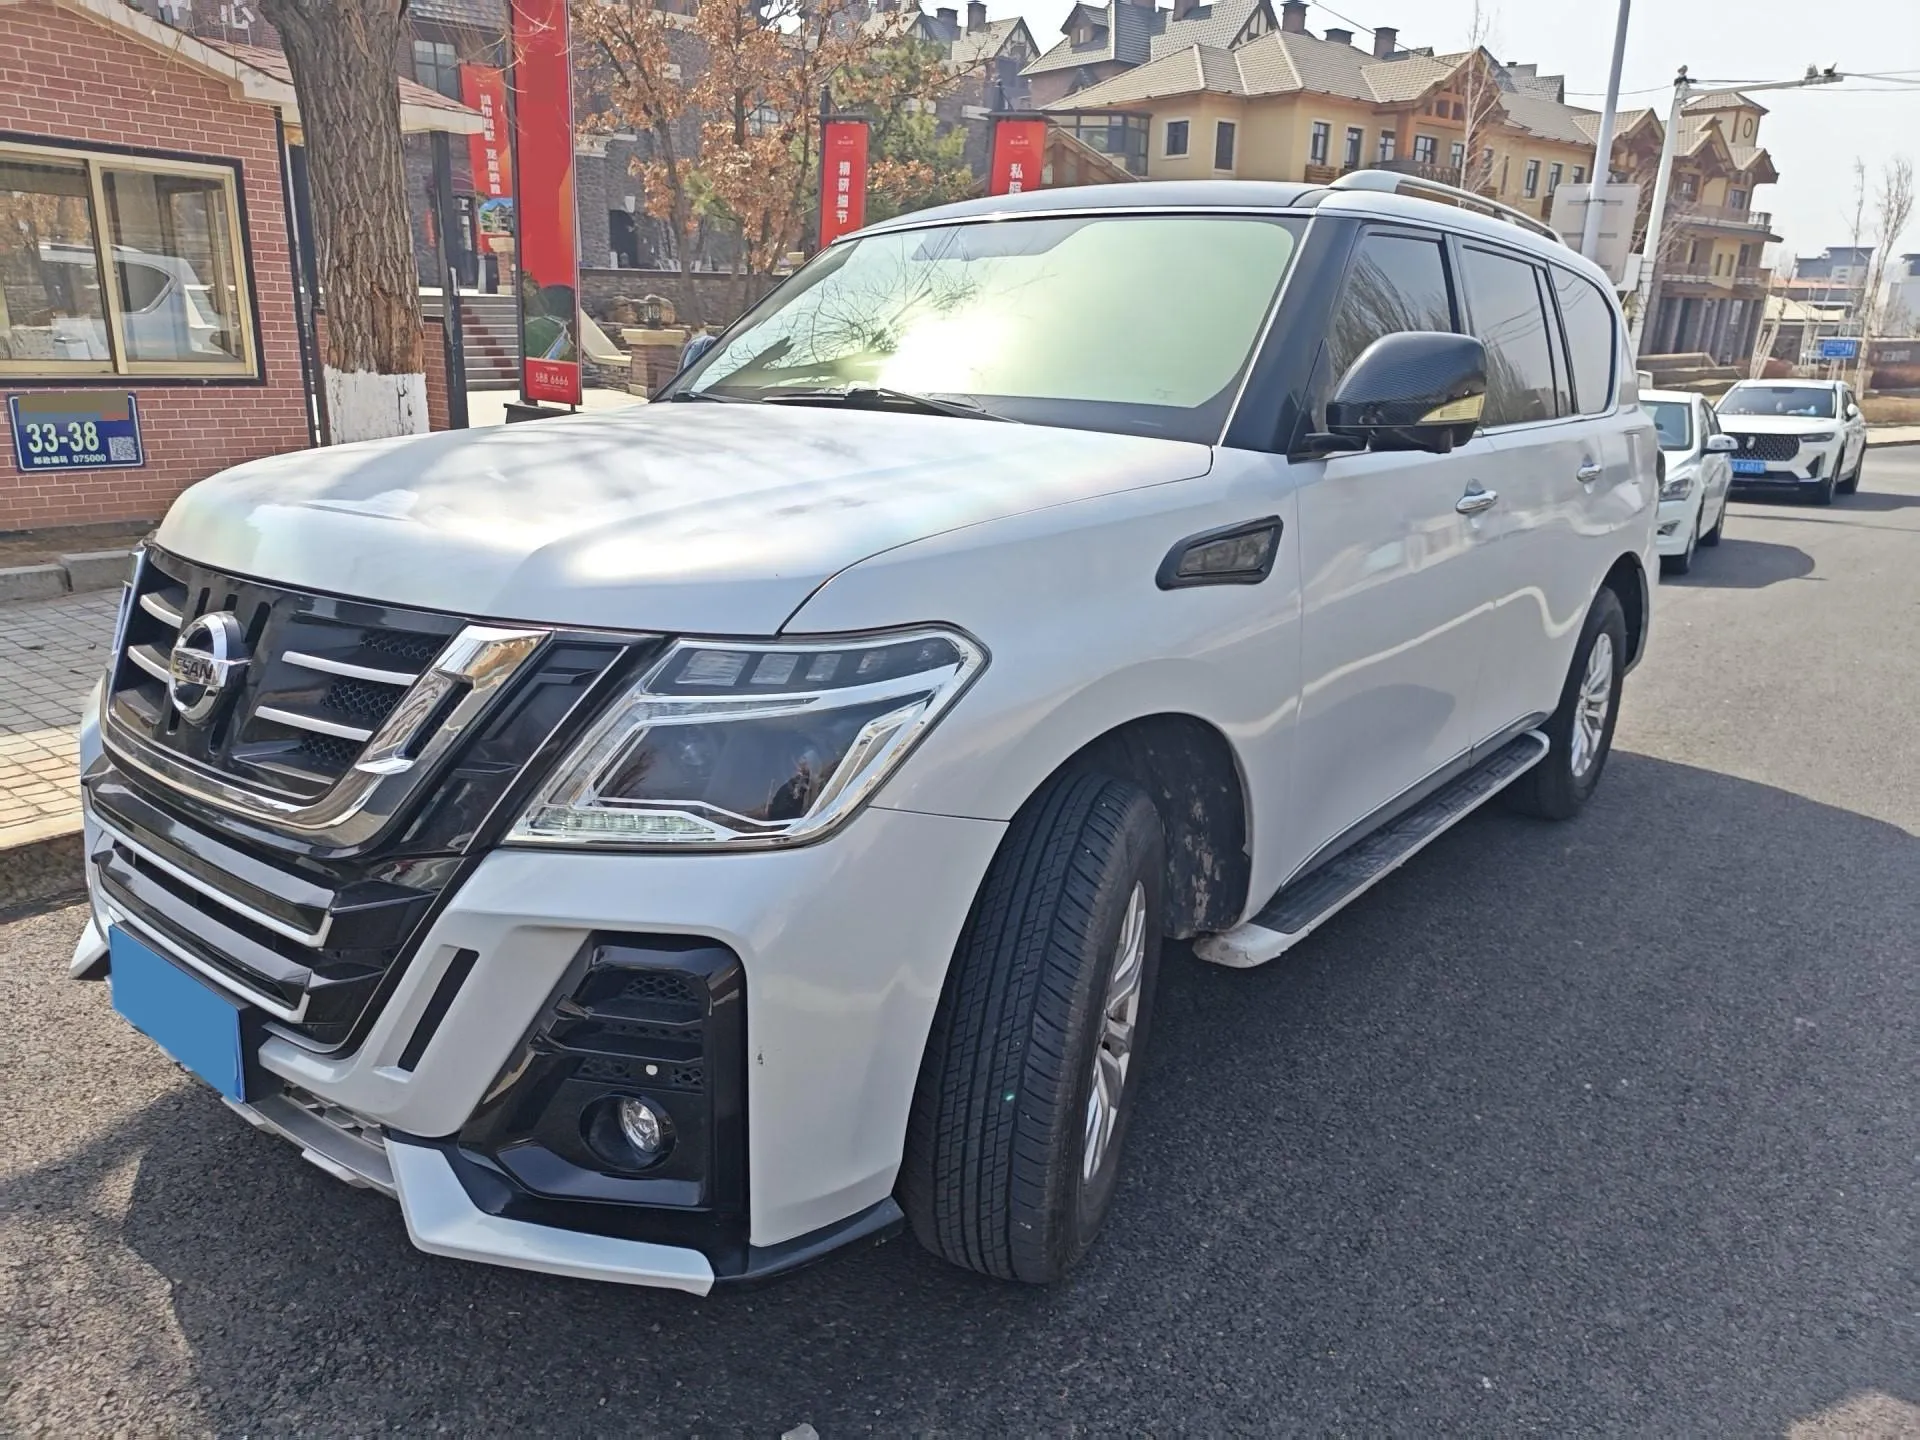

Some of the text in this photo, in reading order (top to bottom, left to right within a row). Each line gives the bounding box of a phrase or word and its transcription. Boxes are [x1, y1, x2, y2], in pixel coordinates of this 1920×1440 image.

[836, 161, 851, 225] 精研细节
[26, 421, 99, 453] 33-38
[72, 454, 107, 463] 075000
